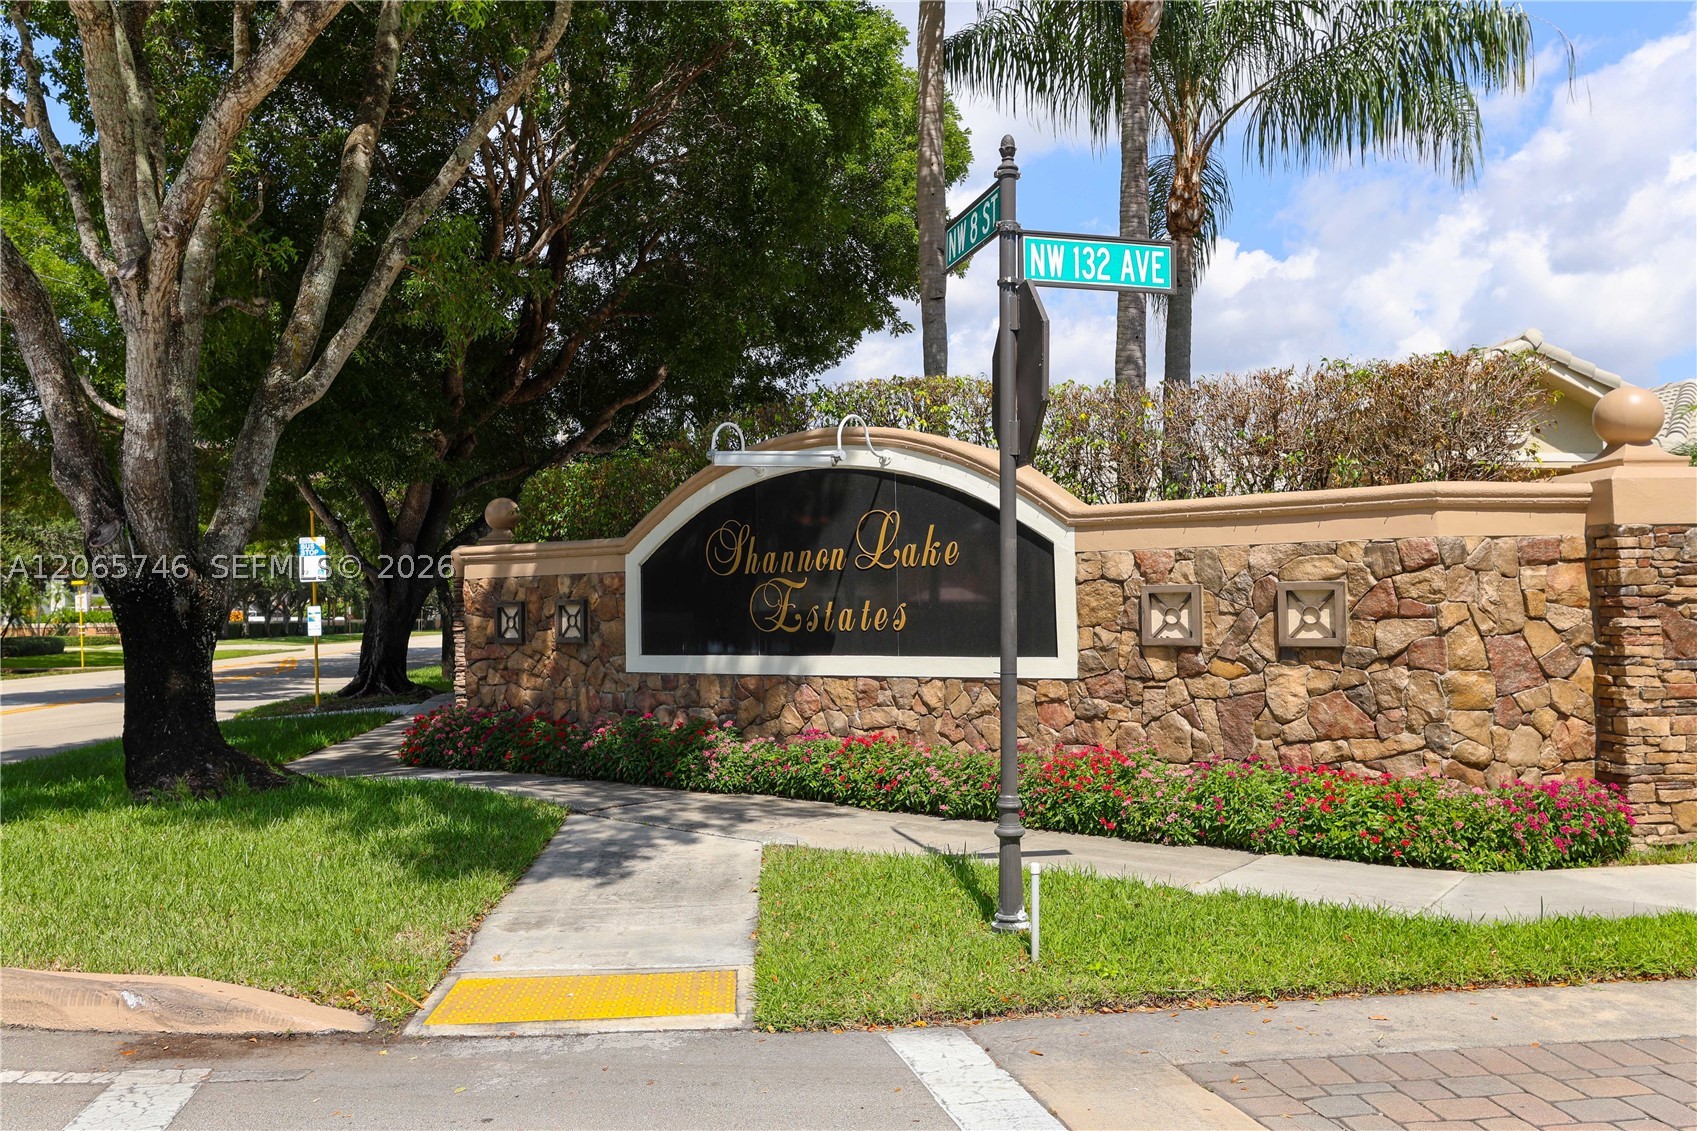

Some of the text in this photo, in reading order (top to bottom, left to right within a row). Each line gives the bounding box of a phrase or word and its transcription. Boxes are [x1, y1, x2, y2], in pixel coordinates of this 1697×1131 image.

[948, 192, 999, 262] NW 8 ST
[1030, 243, 1165, 284] NW 132 AVE
[705, 509, 960, 576] Shannon Lake
[750, 577, 907, 633] Estates
